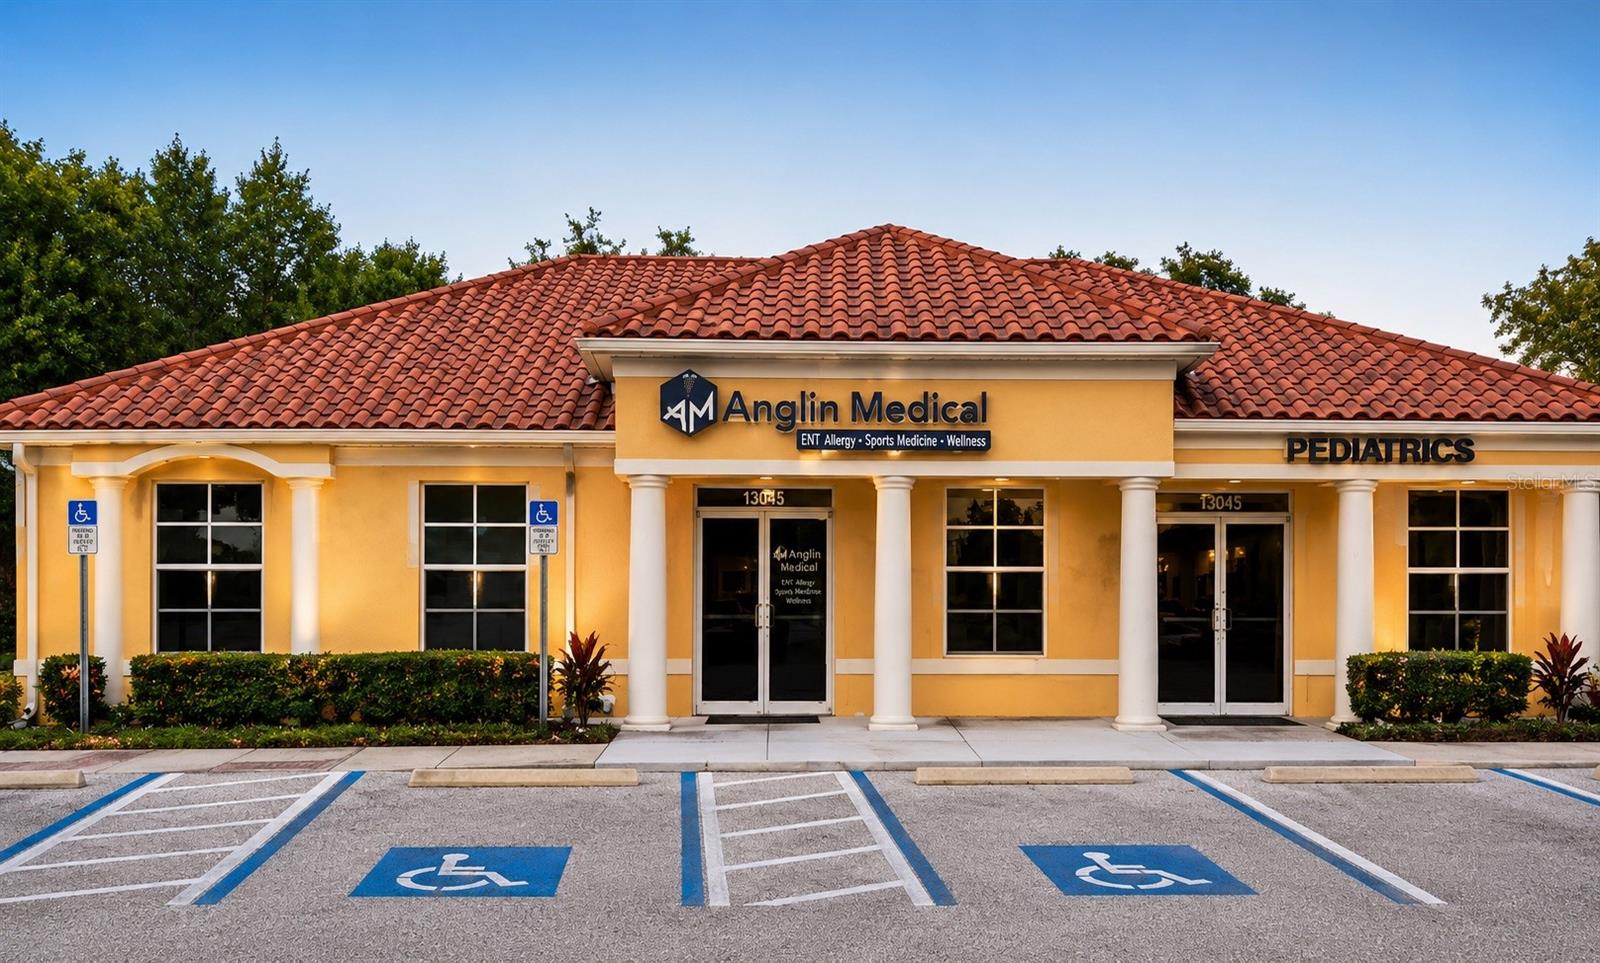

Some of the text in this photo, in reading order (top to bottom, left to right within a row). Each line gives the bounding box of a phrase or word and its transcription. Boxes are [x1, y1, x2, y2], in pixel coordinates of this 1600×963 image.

[662, 390, 714, 433] AM
[722, 390, 987, 432] Anglin Medical
[801, 433, 986, 449] ENT Allergy Sports Medicine Wellness
[1287, 437, 1476, 463] PEDIATRICS
[743, 490, 785, 506] 13045
[1200, 495, 1242, 511] 13045
[789, 548, 821, 562] Anglin
[780, 561, 818, 572] Medical
